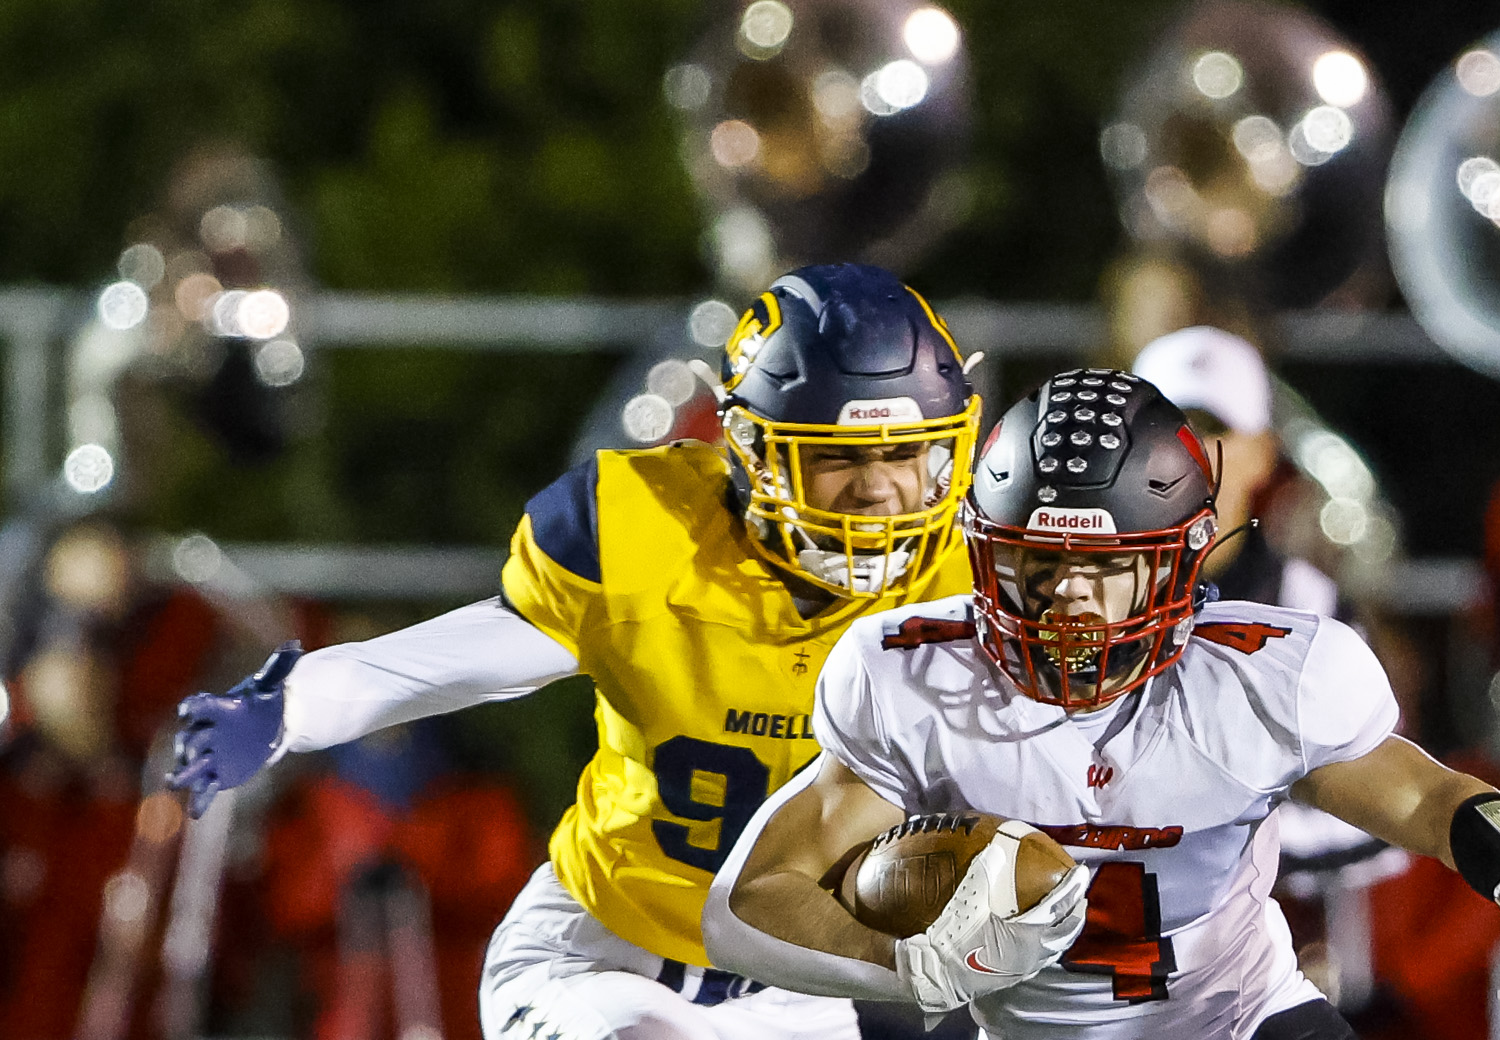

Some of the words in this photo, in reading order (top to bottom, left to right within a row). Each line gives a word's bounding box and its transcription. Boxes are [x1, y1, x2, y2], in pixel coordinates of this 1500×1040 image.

[1038, 512, 1103, 528] Riddell
[725, 708, 815, 739] MOELL
[652, 735, 823, 874] 9
[1058, 860, 1178, 1004] 4
